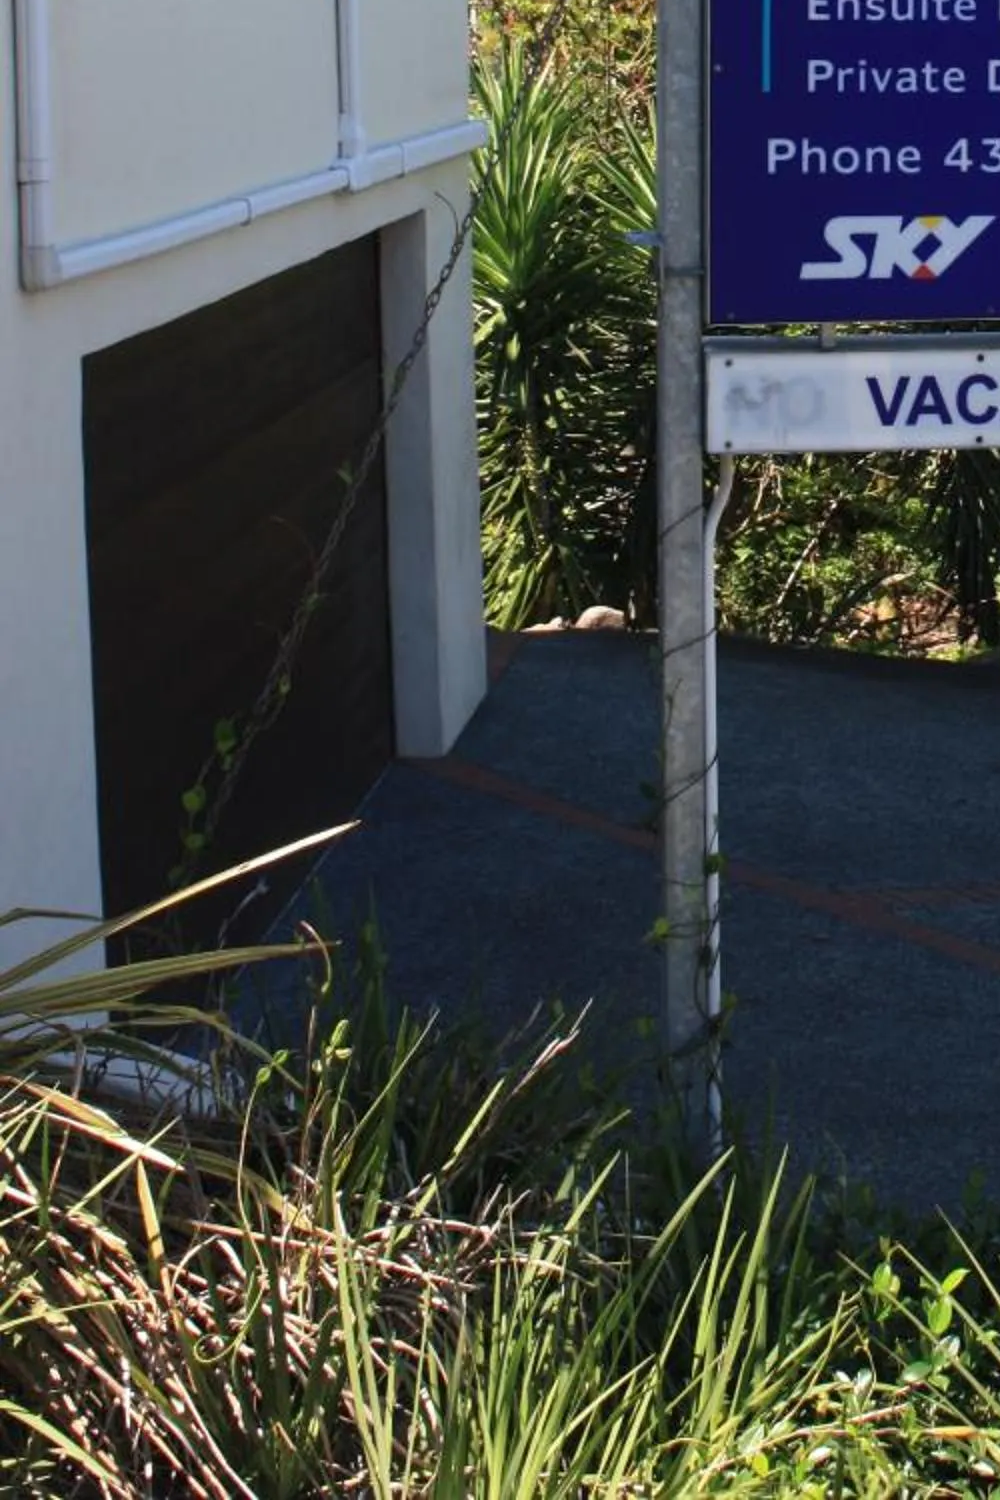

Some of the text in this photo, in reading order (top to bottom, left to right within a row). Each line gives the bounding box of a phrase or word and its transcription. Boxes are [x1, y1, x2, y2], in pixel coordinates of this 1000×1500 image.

[806, 60, 966, 93] Private
[767, 138, 922, 174] Phone
[800, 215, 996, 280] SKY
